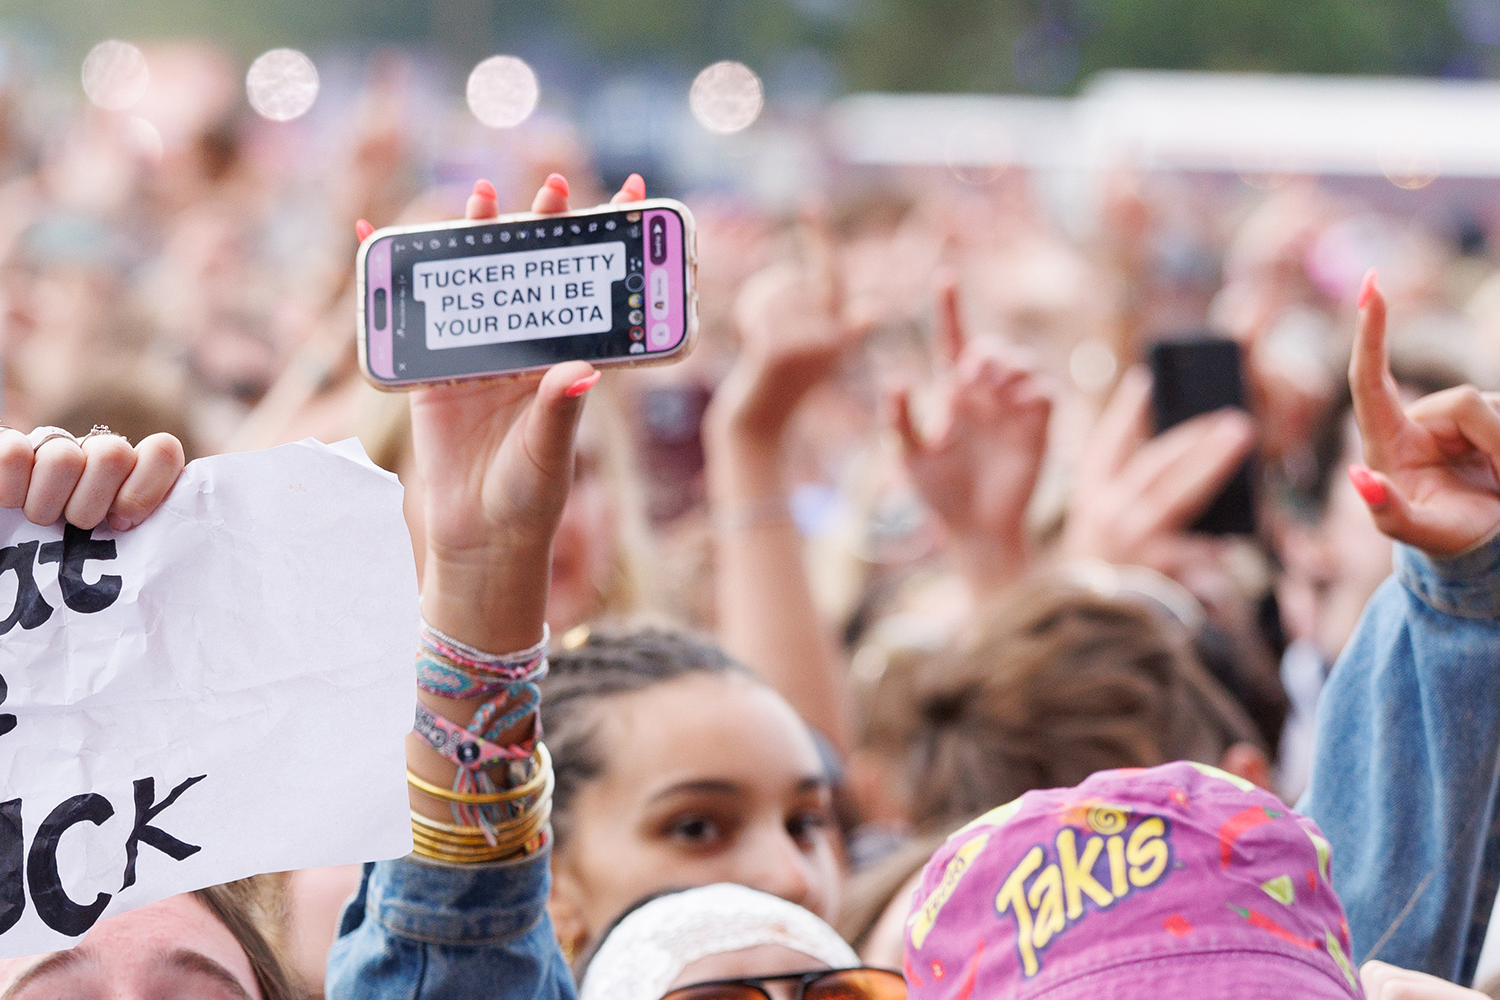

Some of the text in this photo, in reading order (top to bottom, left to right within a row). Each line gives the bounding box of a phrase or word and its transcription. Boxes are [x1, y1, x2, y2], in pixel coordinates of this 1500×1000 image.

[420, 253, 615, 289] TUCKER PRETTY
[442, 281, 595, 312] PLS CAN I BE
[434, 305, 603, 337] YOUR DAKOTA
